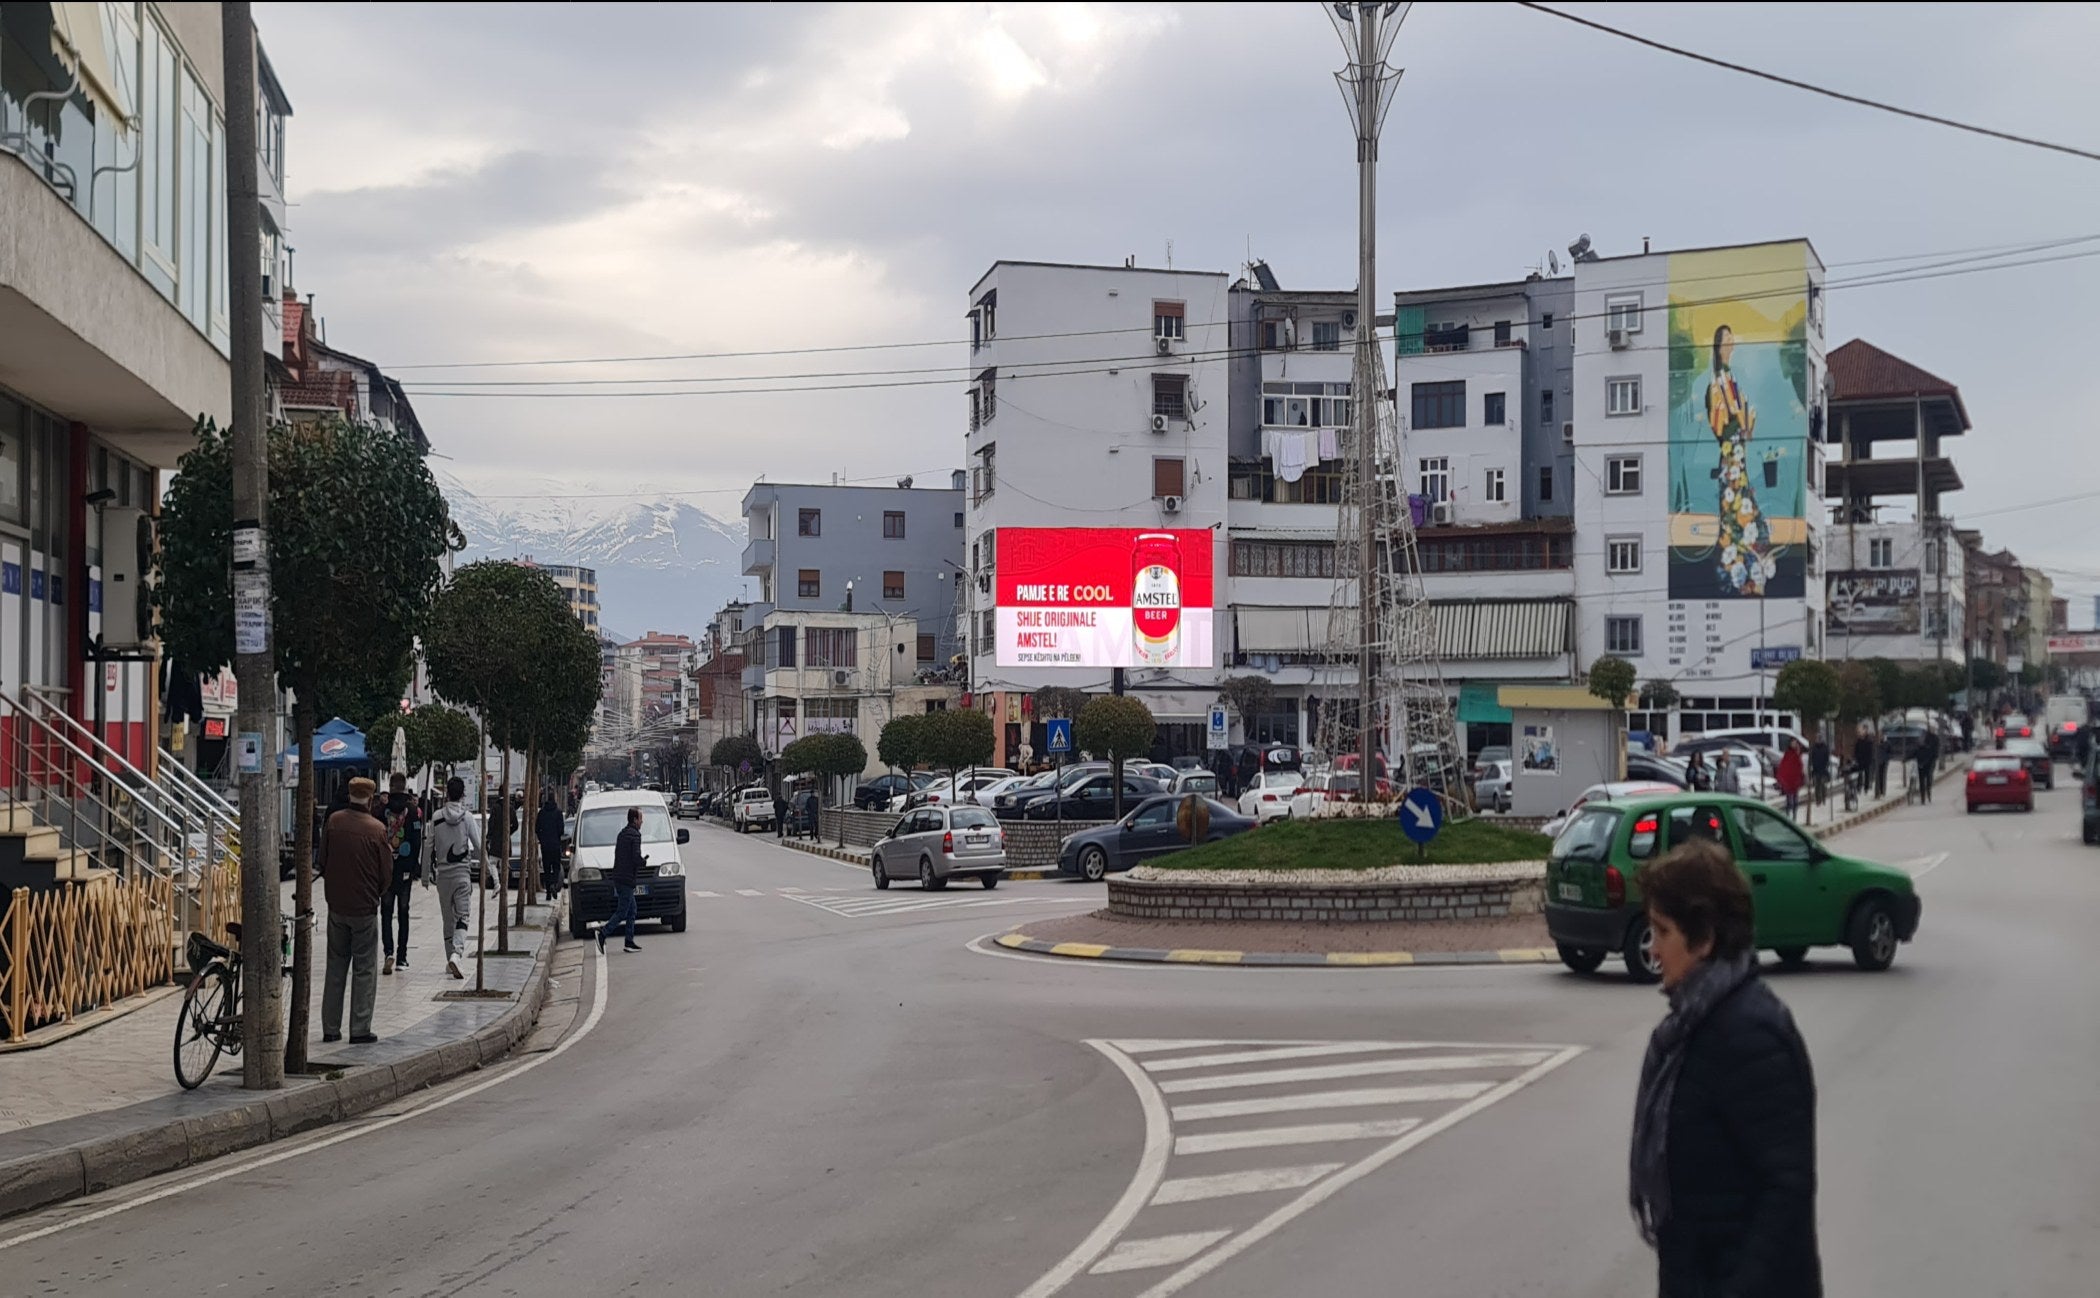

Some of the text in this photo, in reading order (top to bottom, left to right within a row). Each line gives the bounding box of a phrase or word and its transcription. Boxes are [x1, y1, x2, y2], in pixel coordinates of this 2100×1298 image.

[1017, 584, 1114, 601] PAMJE E RE COOL
[1136, 592, 1177, 605] AMSTEL
[1017, 611, 1096, 627] SHIJE ORIGJINALE
[1144, 610, 1167, 620] BEER
[1017, 632, 1057, 648] AMSTEL!
[1053, 653, 1060, 662] NA
